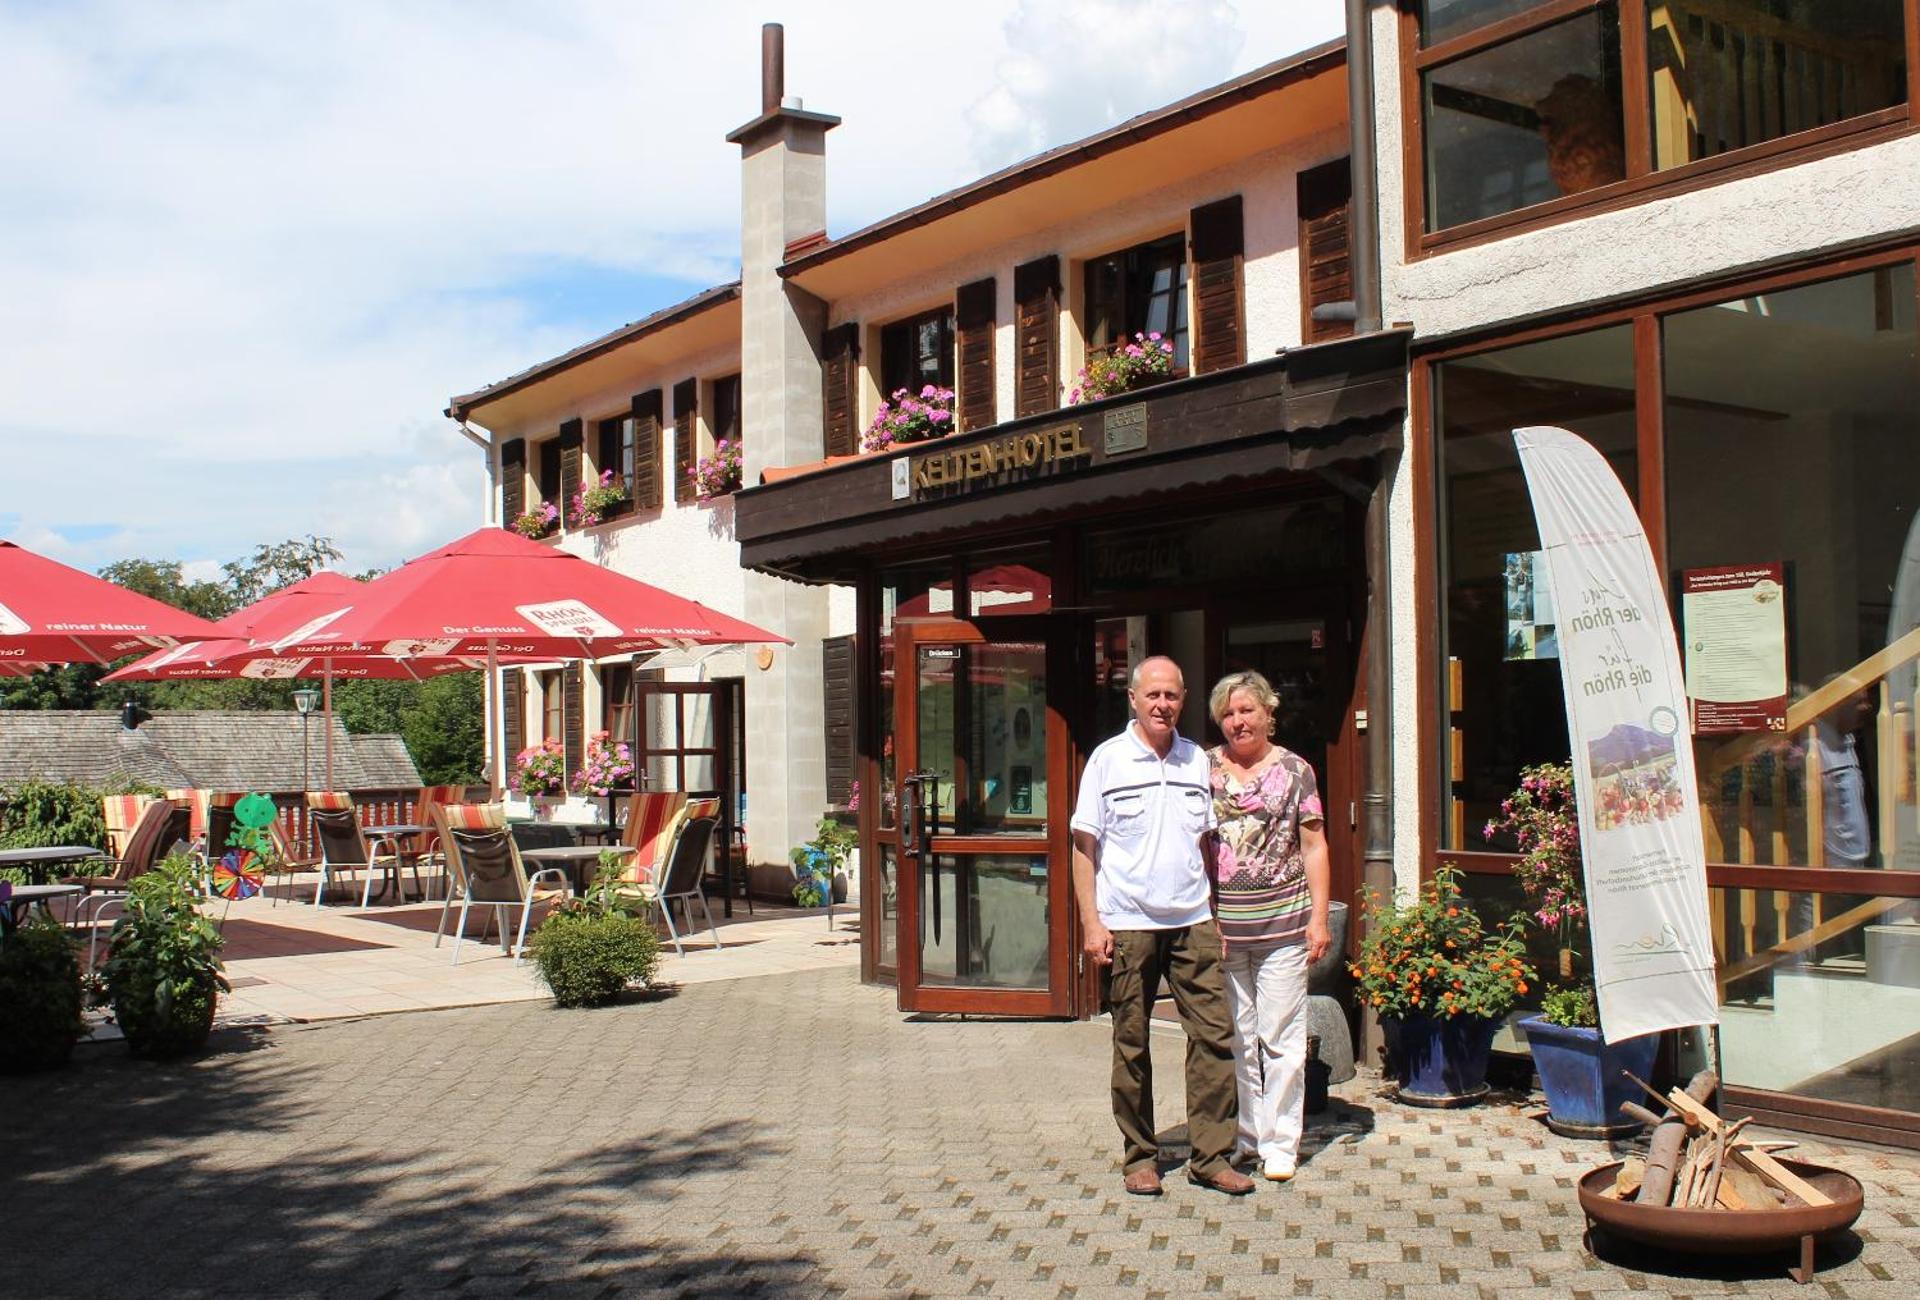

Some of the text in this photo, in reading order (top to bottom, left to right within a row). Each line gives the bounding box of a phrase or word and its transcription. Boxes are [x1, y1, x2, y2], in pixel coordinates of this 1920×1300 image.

[913, 422, 1092, 488] KELTENHOTEL
[530, 607, 586, 621] RHÖN
[45, 623, 149, 632] reiner Natur
[443, 626, 525, 635] Der Genuss
[634, 627, 711, 637] reiner Natur
